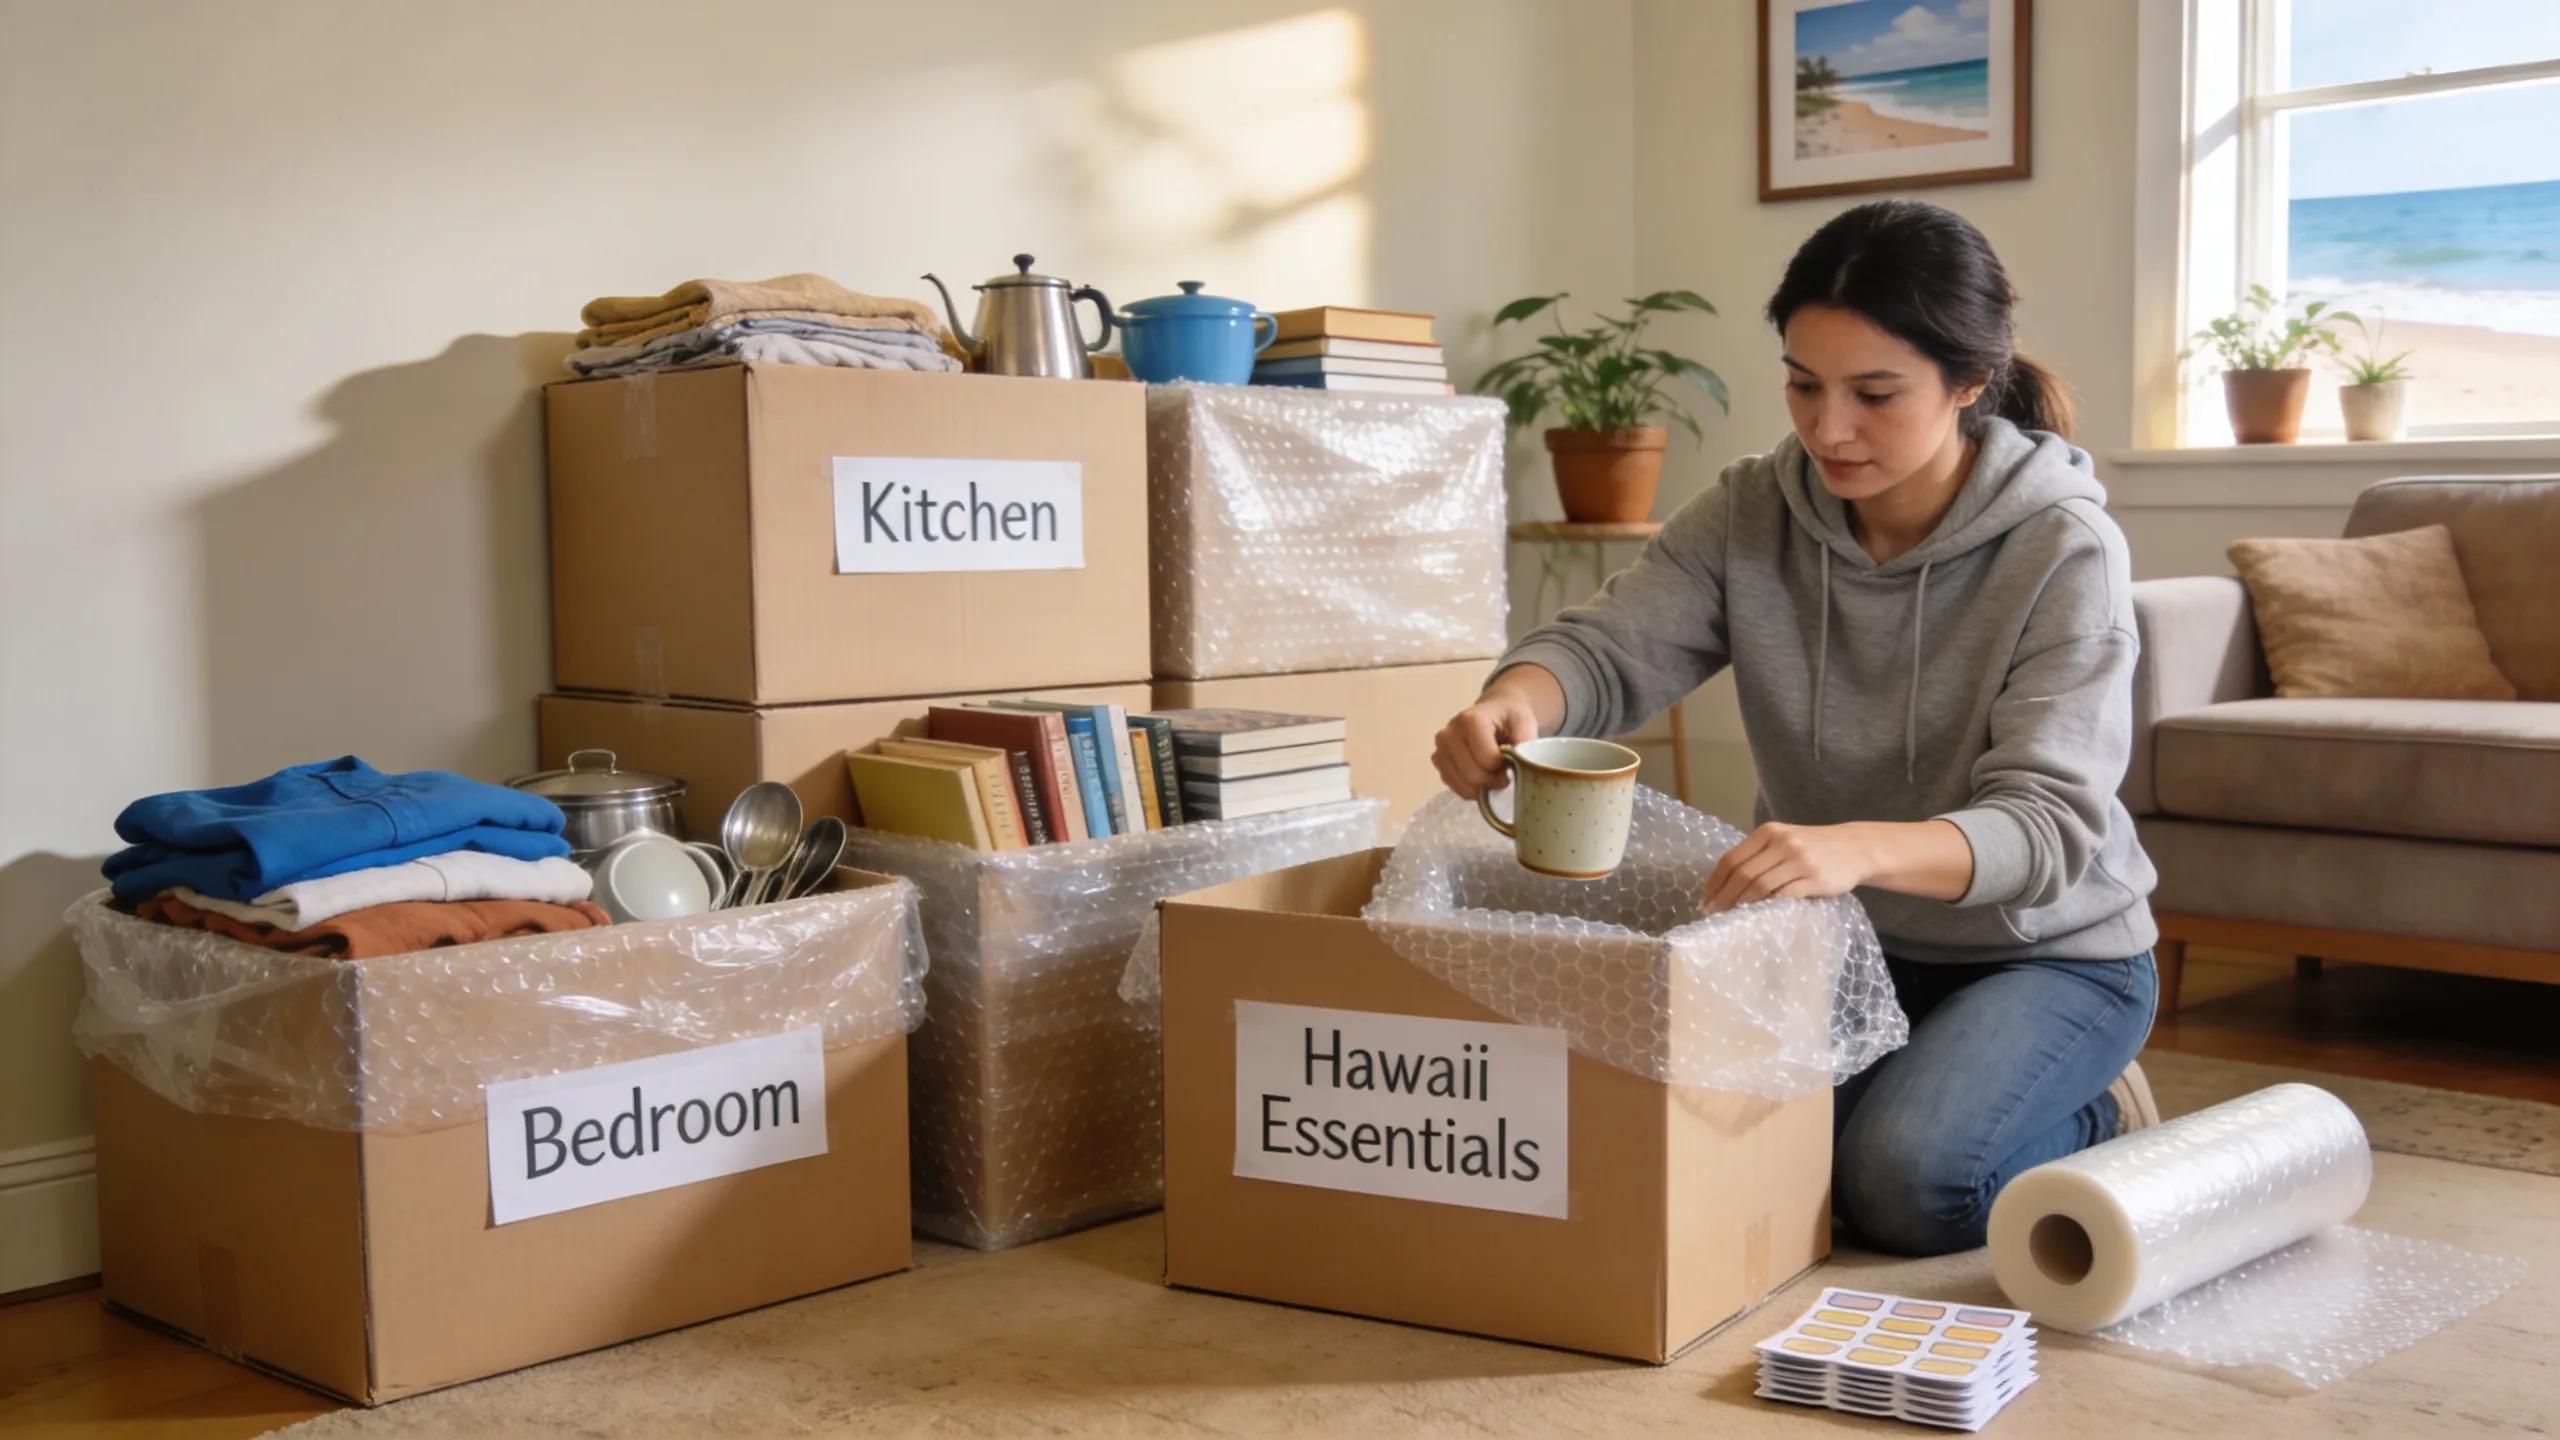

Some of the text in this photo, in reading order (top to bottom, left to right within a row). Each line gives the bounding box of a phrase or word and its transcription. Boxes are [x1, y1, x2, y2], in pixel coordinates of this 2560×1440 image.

[862, 481, 1057, 543] Kitchen
[1304, 1025, 1489, 1102] Hawaii
[521, 1080, 801, 1181] Bedroom
[1261, 1093, 1541, 1183] Essentials
